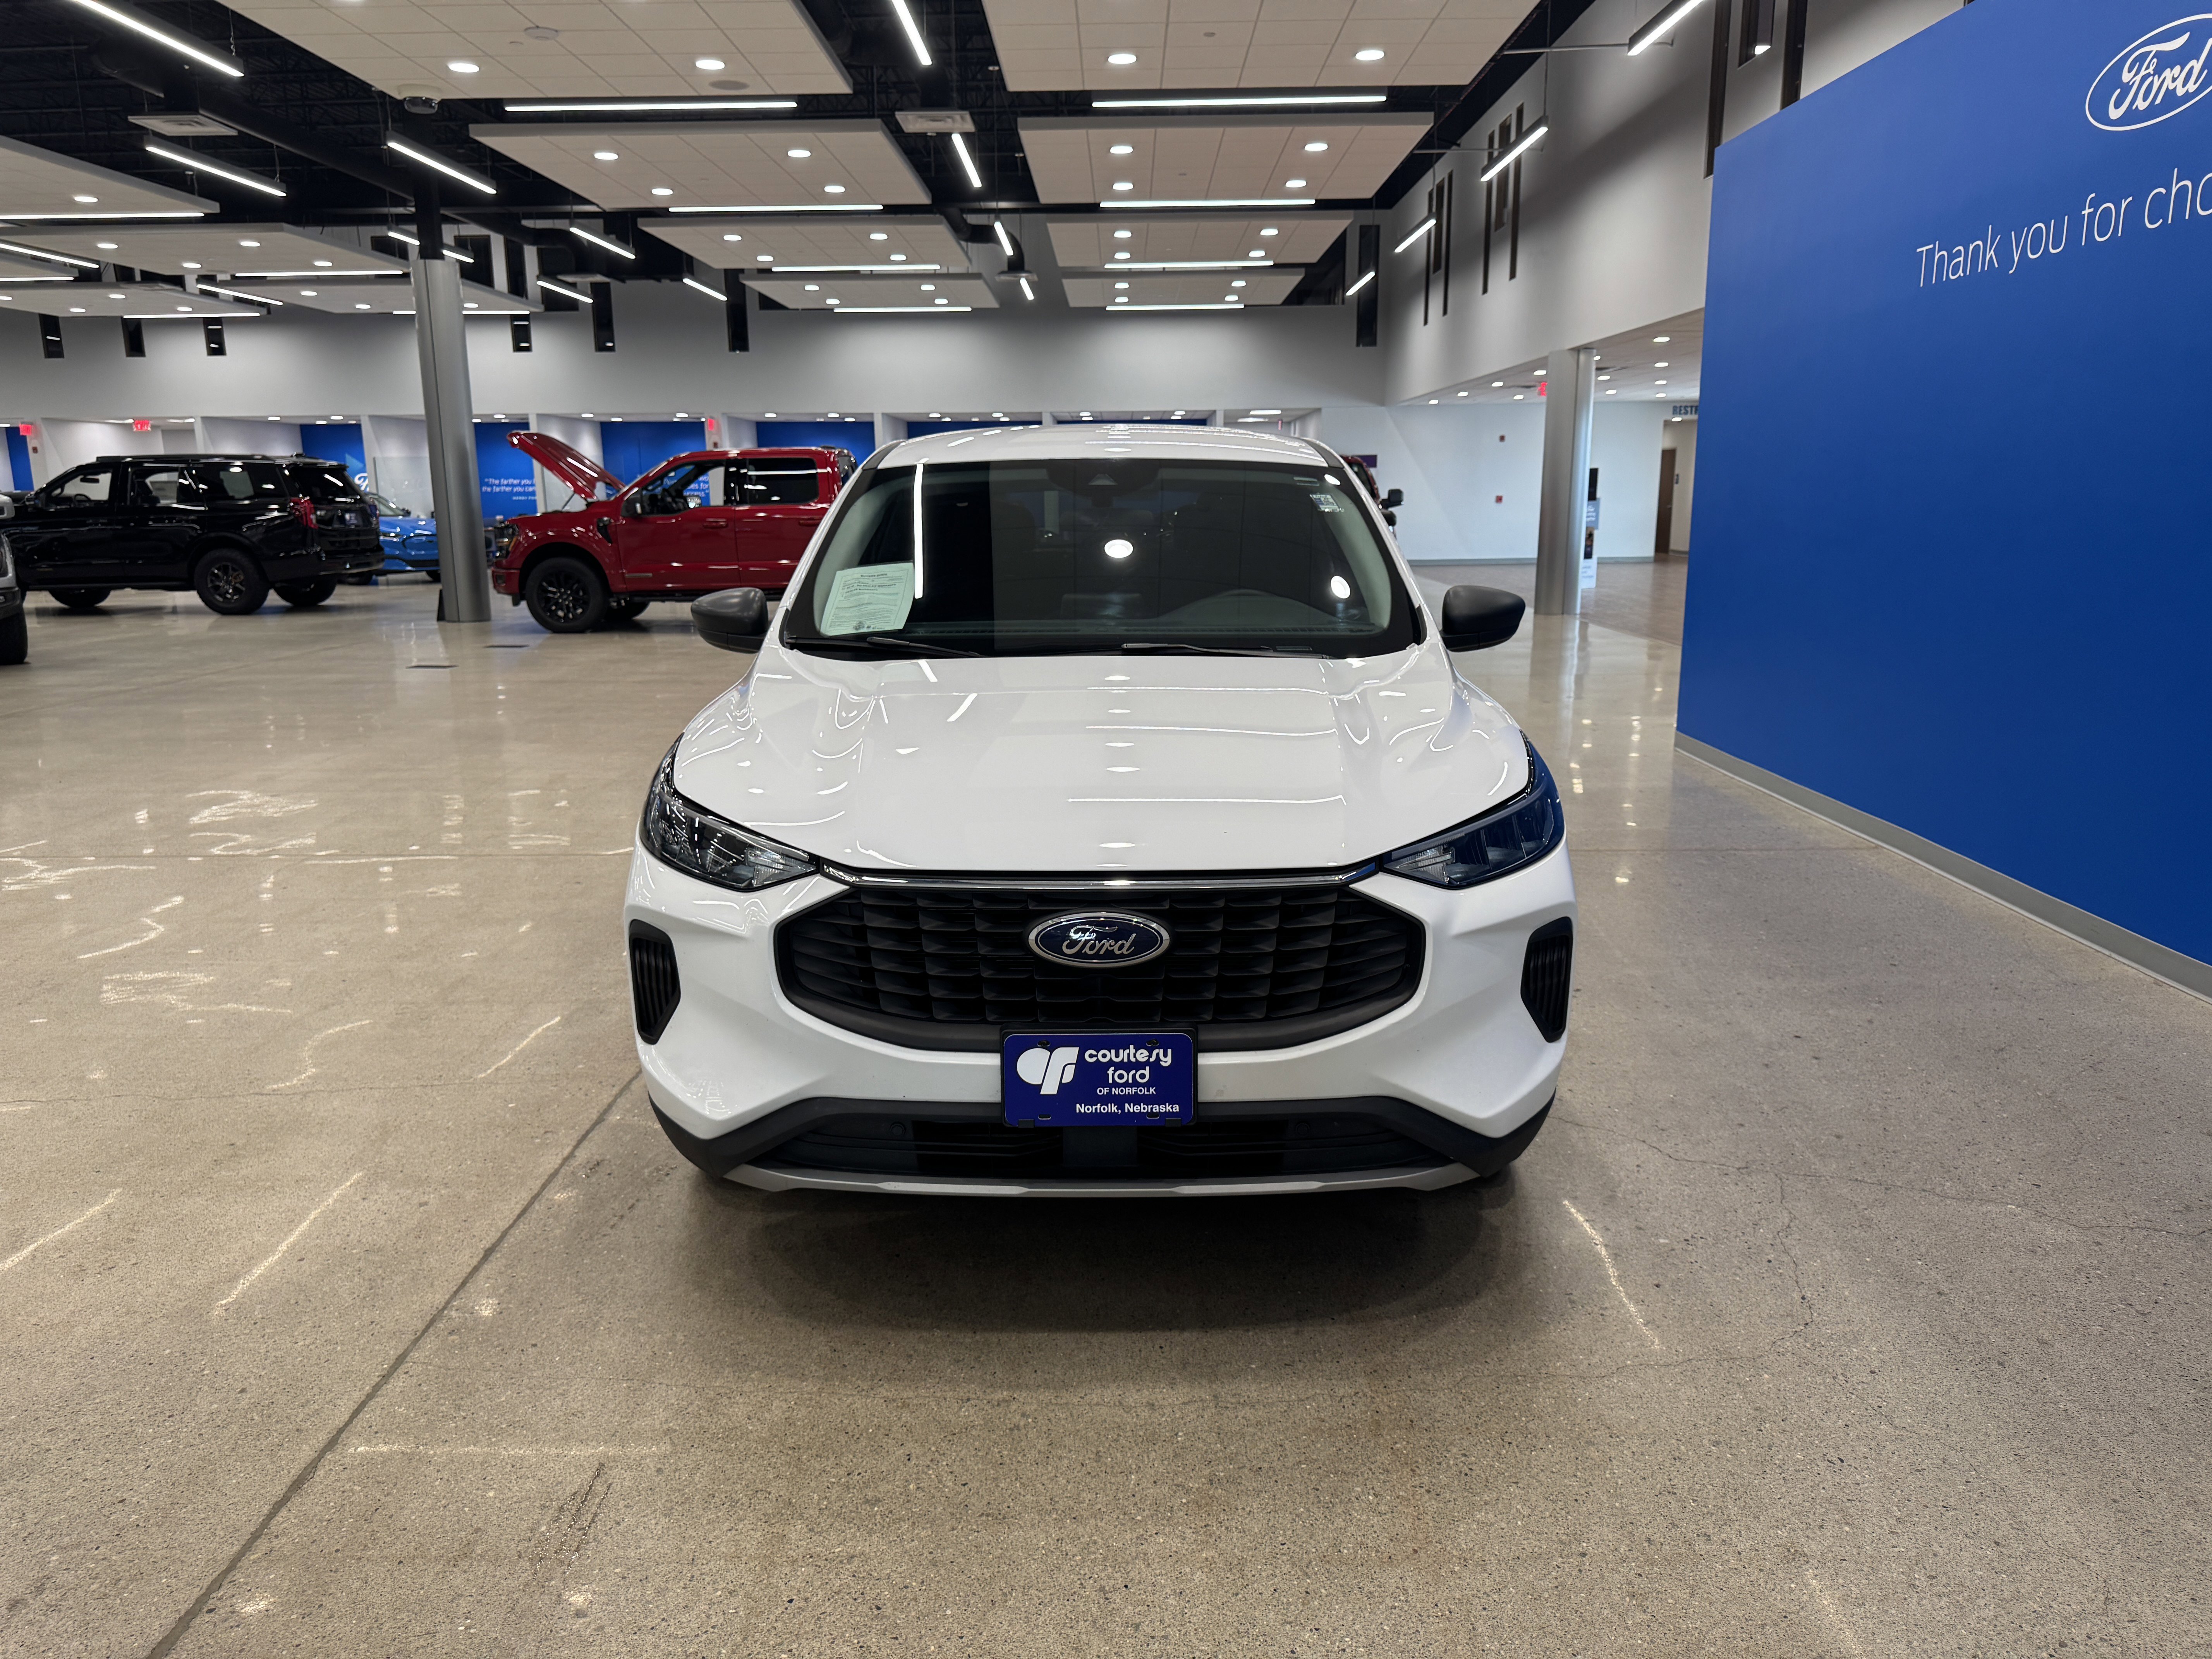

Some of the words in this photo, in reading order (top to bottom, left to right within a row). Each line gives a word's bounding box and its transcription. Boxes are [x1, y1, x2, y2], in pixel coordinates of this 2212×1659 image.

[2108, 31, 2212, 120] Ford
[1916, 225, 2001, 287] Thank
[2009, 215, 2068, 274] you
[2081, 193, 2133, 246] for
[1062, 925, 1136, 955] Ford
[1084, 1045, 1172, 1066] courtesy
[1107, 1066, 1150, 1083] ford
[1097, 1087, 1110, 1095] OF
[1112, 1087, 1156, 1095] NORFOLK
[1076, 1103, 1121, 1114] Norfolk,
[1125, 1103, 1180, 1113] Nebraska
